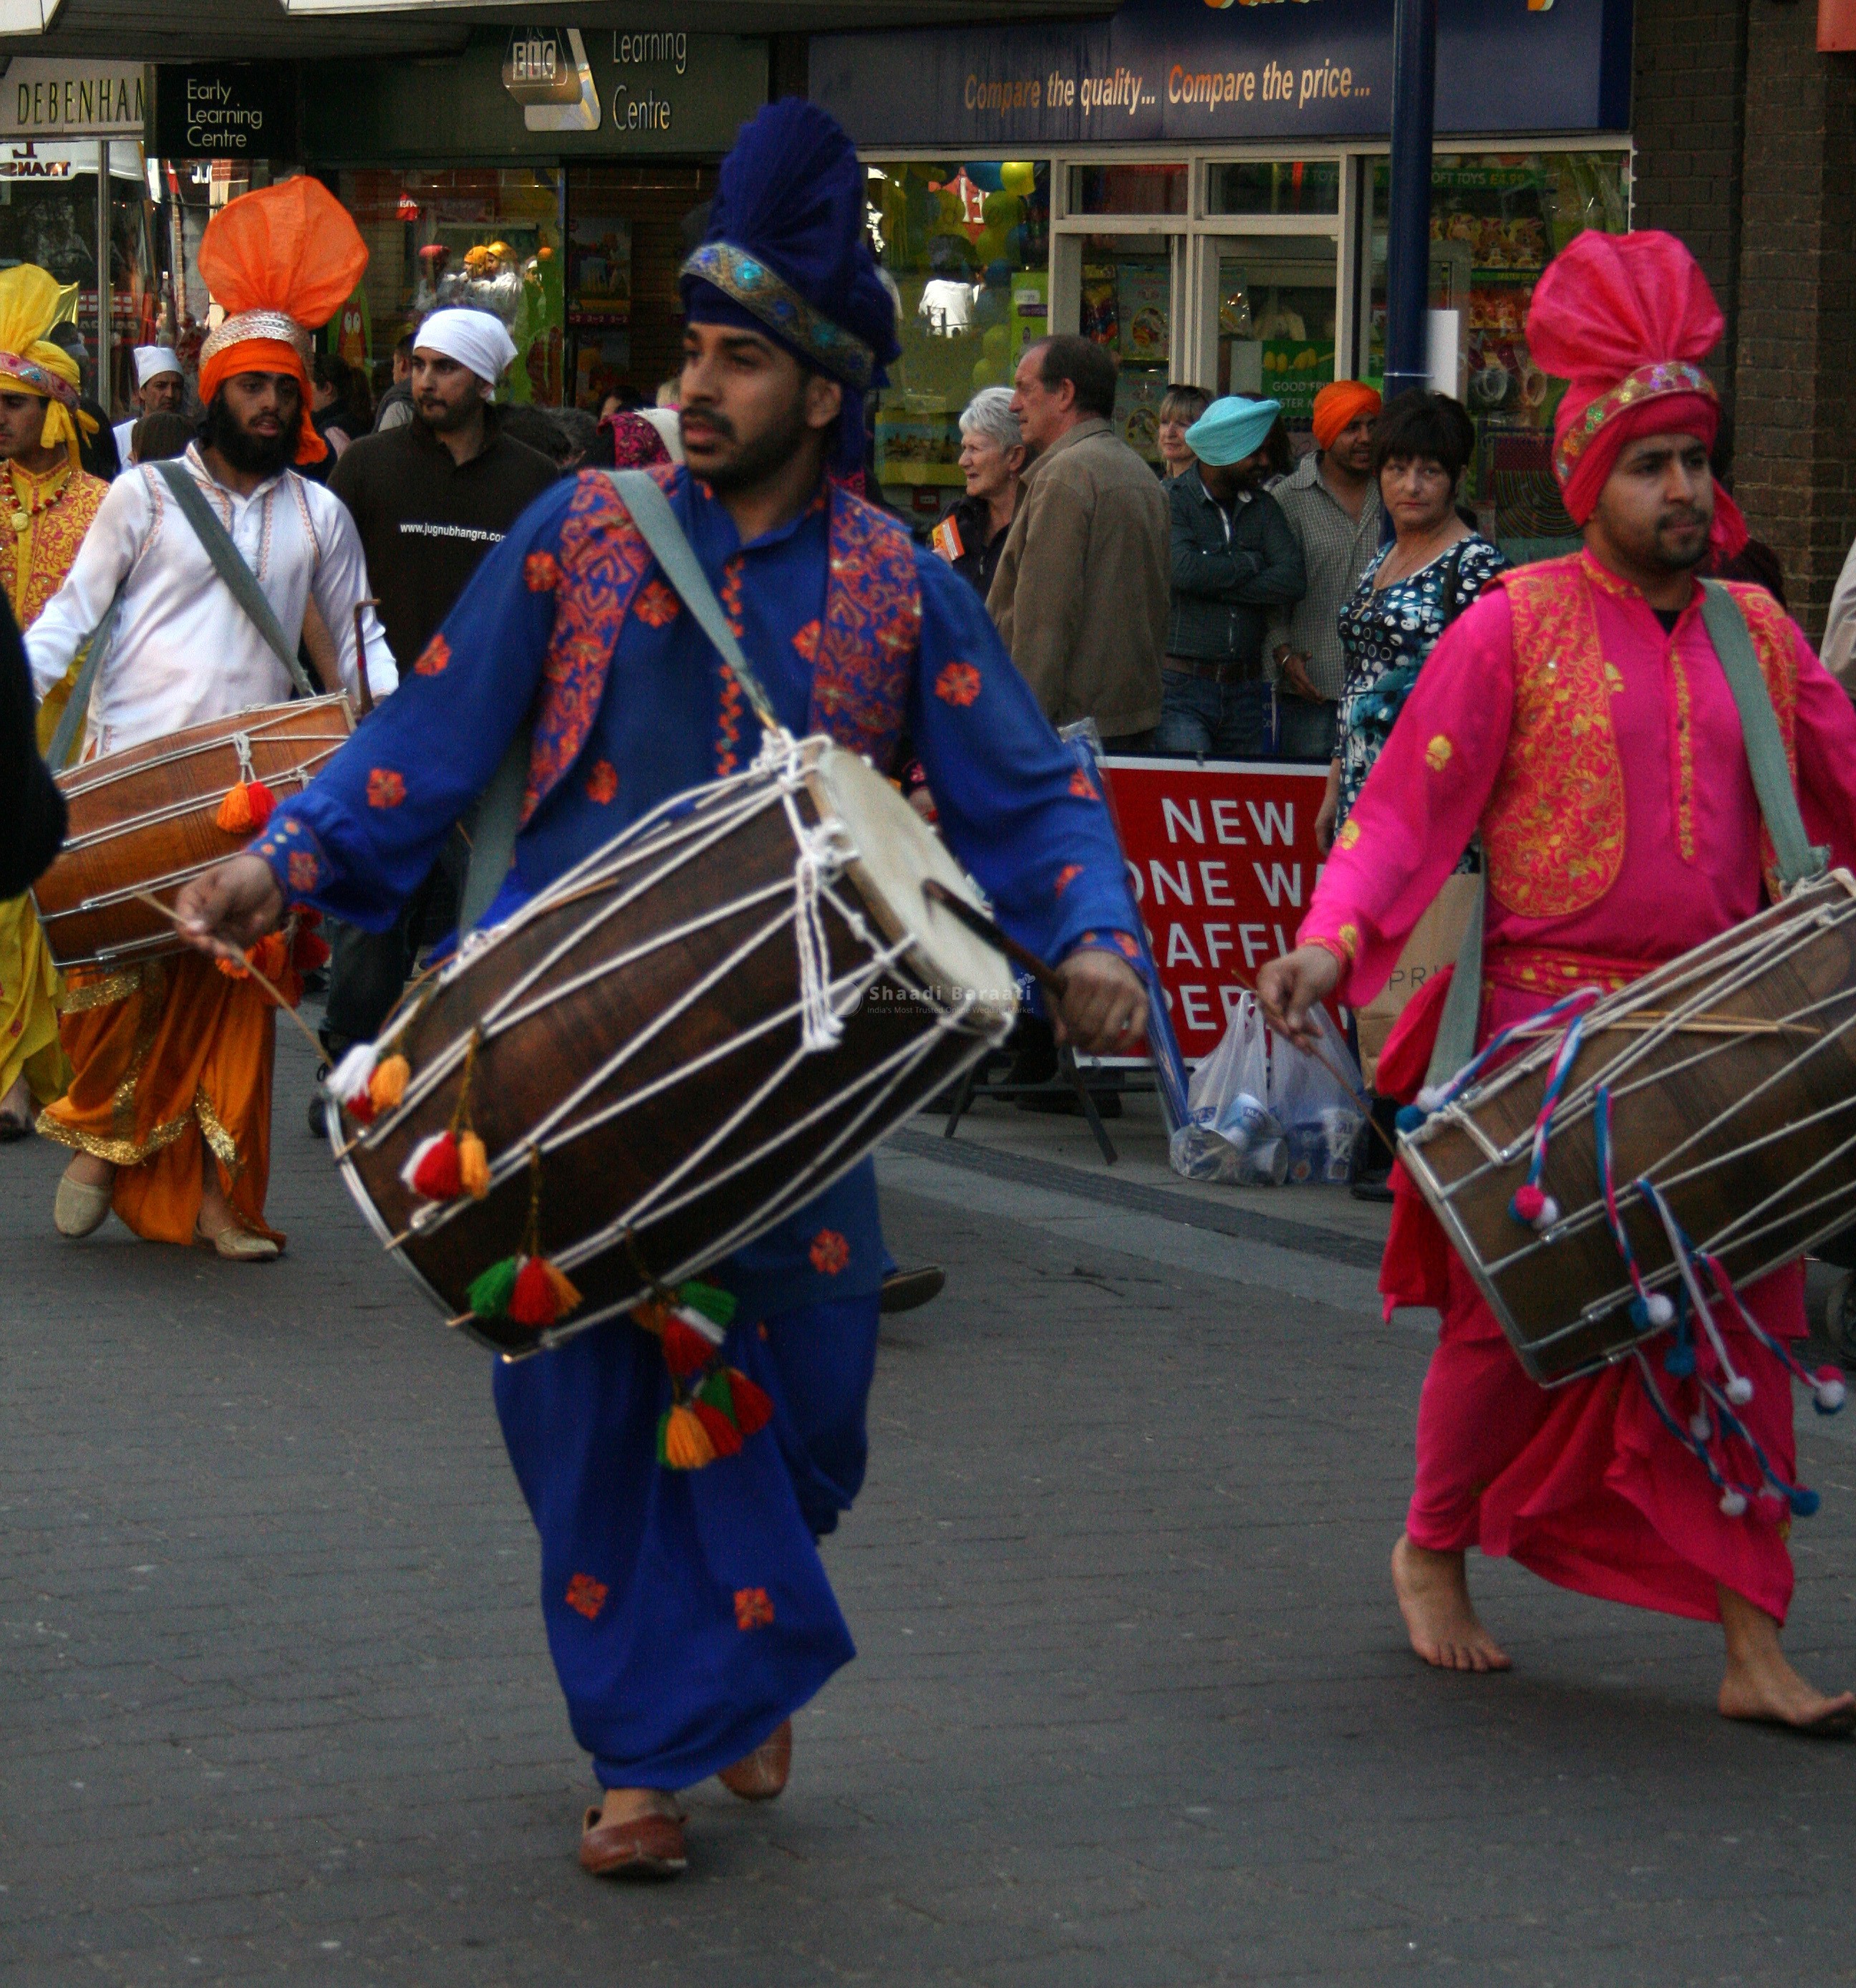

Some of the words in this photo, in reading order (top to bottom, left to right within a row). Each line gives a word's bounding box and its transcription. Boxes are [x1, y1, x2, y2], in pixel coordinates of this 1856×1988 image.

[613, 31, 686, 74] Learning
[187, 78, 232, 105] Early
[965, 73, 1041, 117] Compare
[1046, 70, 1075, 107] the
[1081, 68, 1156, 116] quality...
[1168, 63, 1255, 112] Compare
[1262, 60, 1294, 101] the
[1299, 58, 1371, 110] price...
[187, 102, 263, 130] Learning
[613, 85, 671, 131] Centre
[187, 125, 248, 148] Centre
[1272, 381, 1307, 392] GOOD
[1161, 798, 1294, 846] NEW
